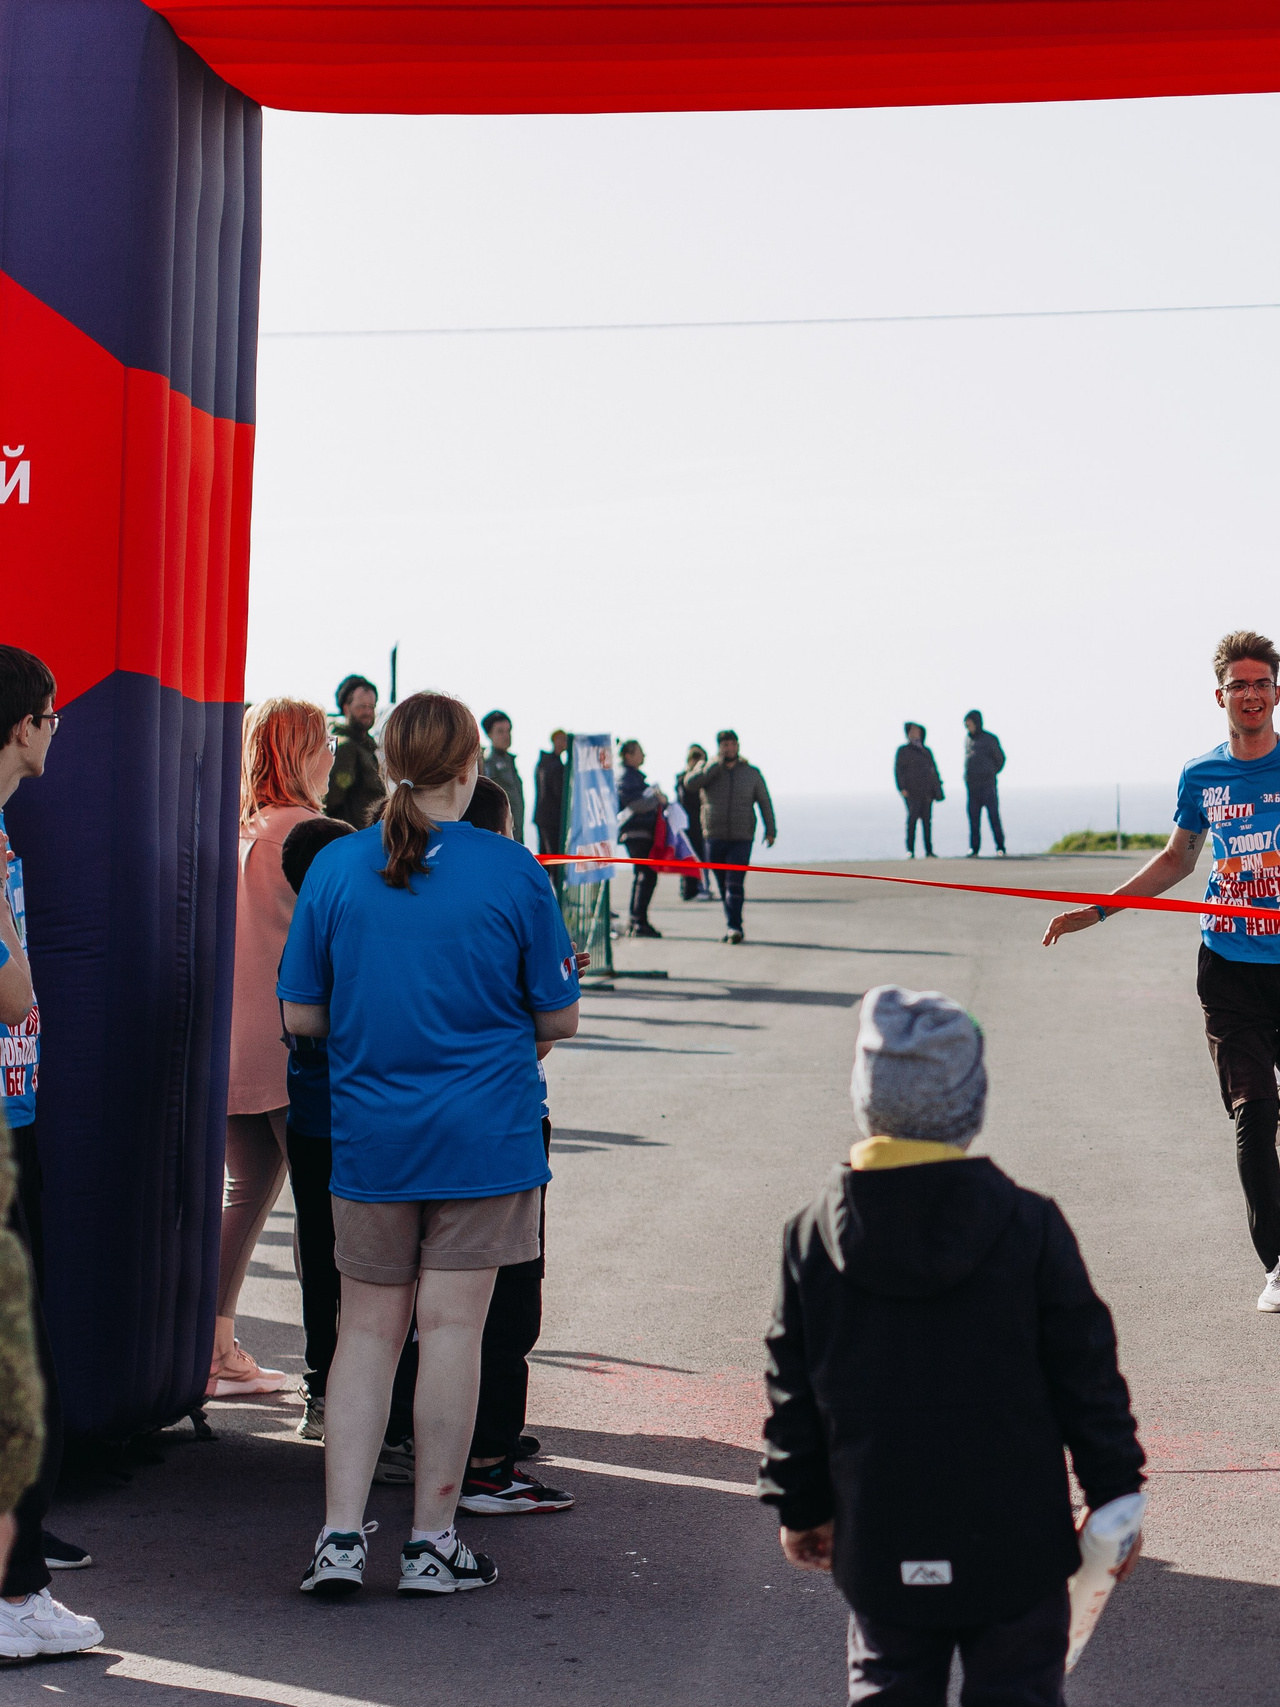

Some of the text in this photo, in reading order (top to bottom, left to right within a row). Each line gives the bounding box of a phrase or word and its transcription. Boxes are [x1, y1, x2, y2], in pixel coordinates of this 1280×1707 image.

[1202, 785, 1230, 808] 2024
[1207, 803, 1254, 823] #МЕЧТА
[1229, 830, 1272, 856] 20007
